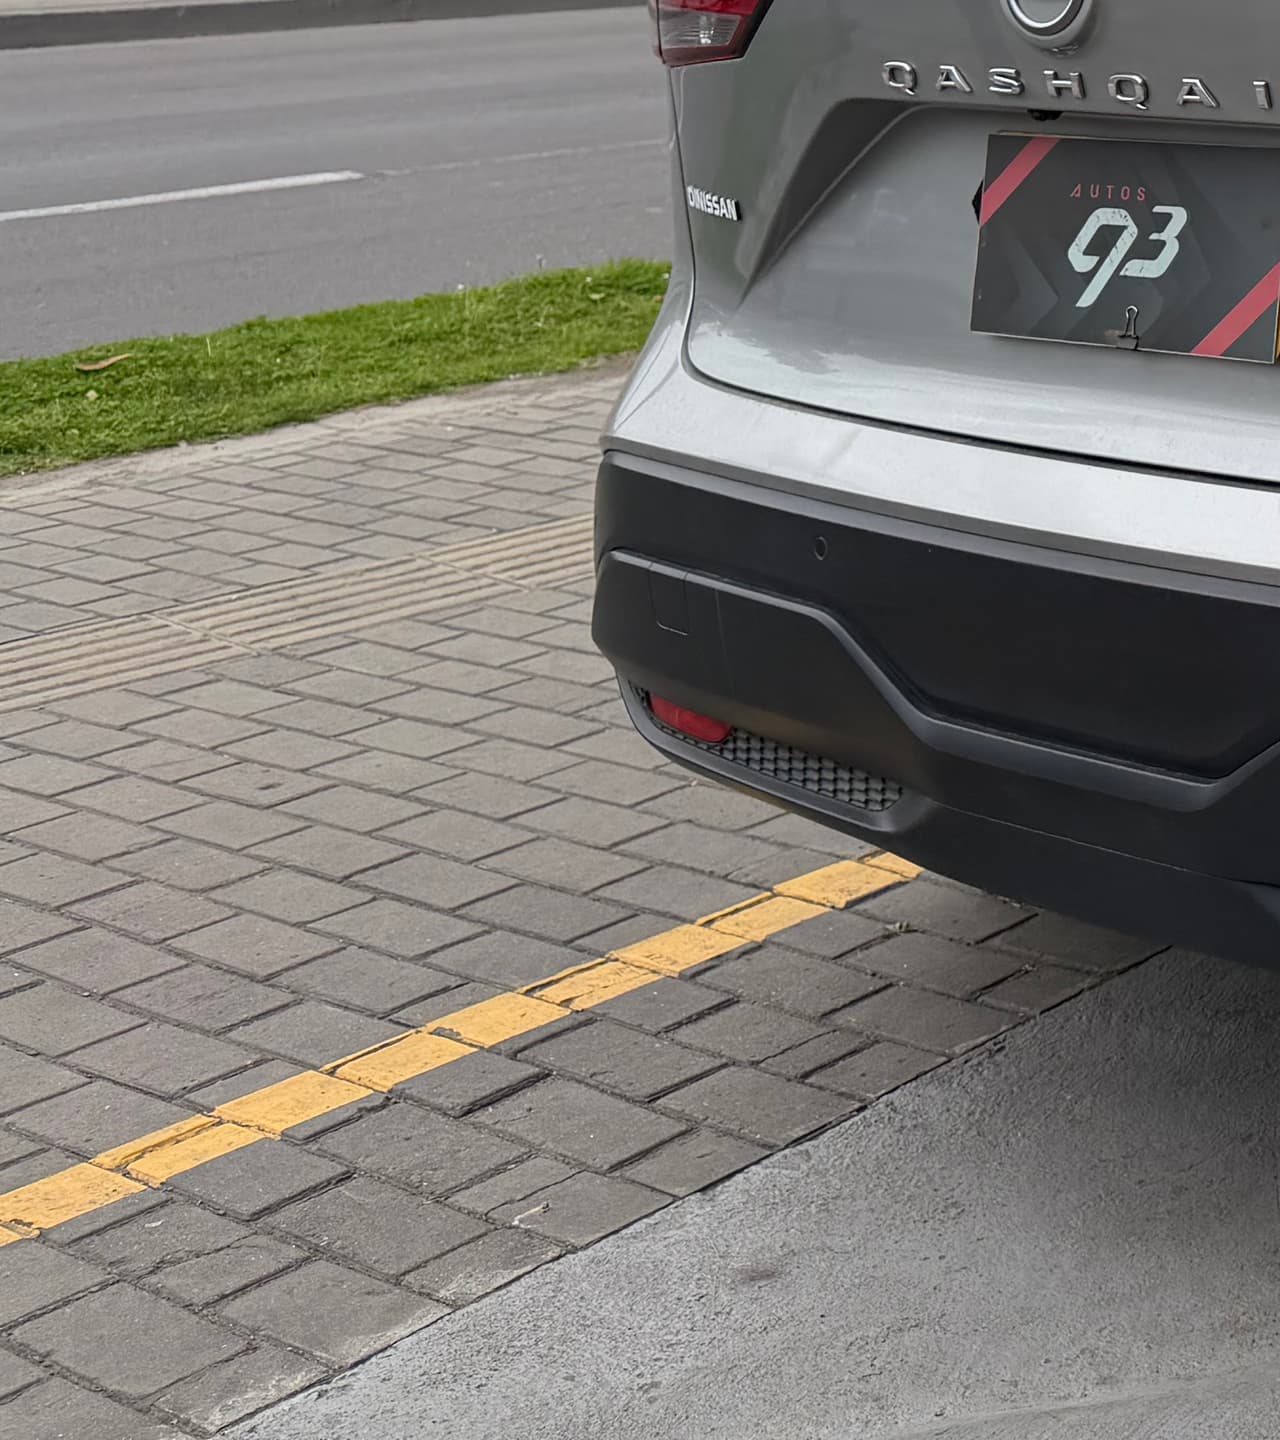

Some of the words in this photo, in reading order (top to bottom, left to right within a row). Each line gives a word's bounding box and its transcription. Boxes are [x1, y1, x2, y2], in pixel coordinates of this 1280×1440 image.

[881, 61, 1274, 110] QASHQAI
[1069, 184, 1147, 201] AUTOS
[1067, 205, 1188, 308] 93
